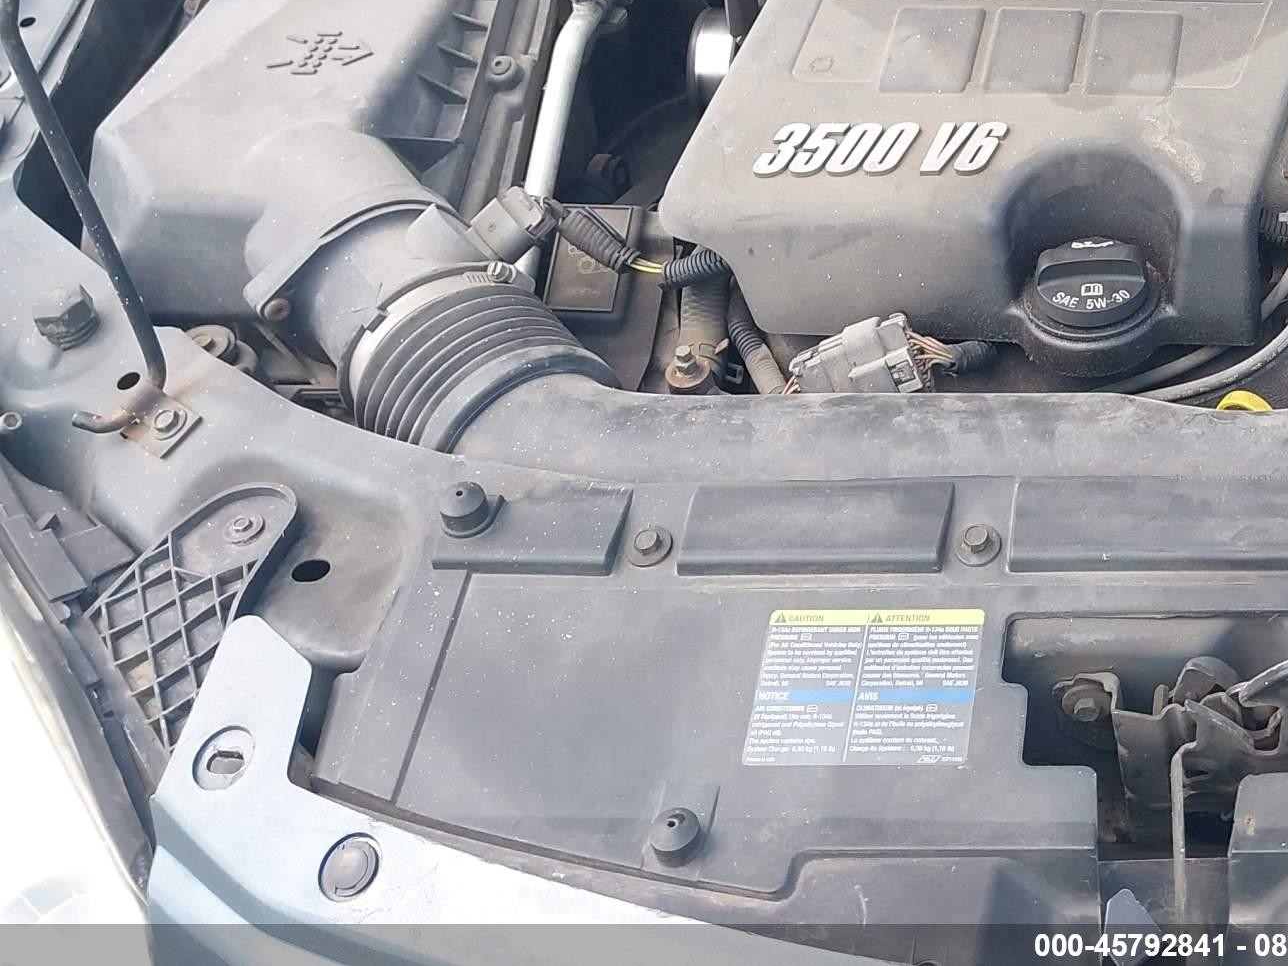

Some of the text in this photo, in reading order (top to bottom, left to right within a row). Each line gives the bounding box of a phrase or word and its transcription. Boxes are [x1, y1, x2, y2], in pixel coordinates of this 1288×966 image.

[753, 121, 1010, 177] 3500 V6
[1052, 289, 1131, 310] SAE 5W-30
[789, 614, 824, 622] CAUTION
[885, 614, 930, 623] ATTENTION
[758, 691, 790, 700] NOTICE
[858, 692, 879, 701] AVIS
